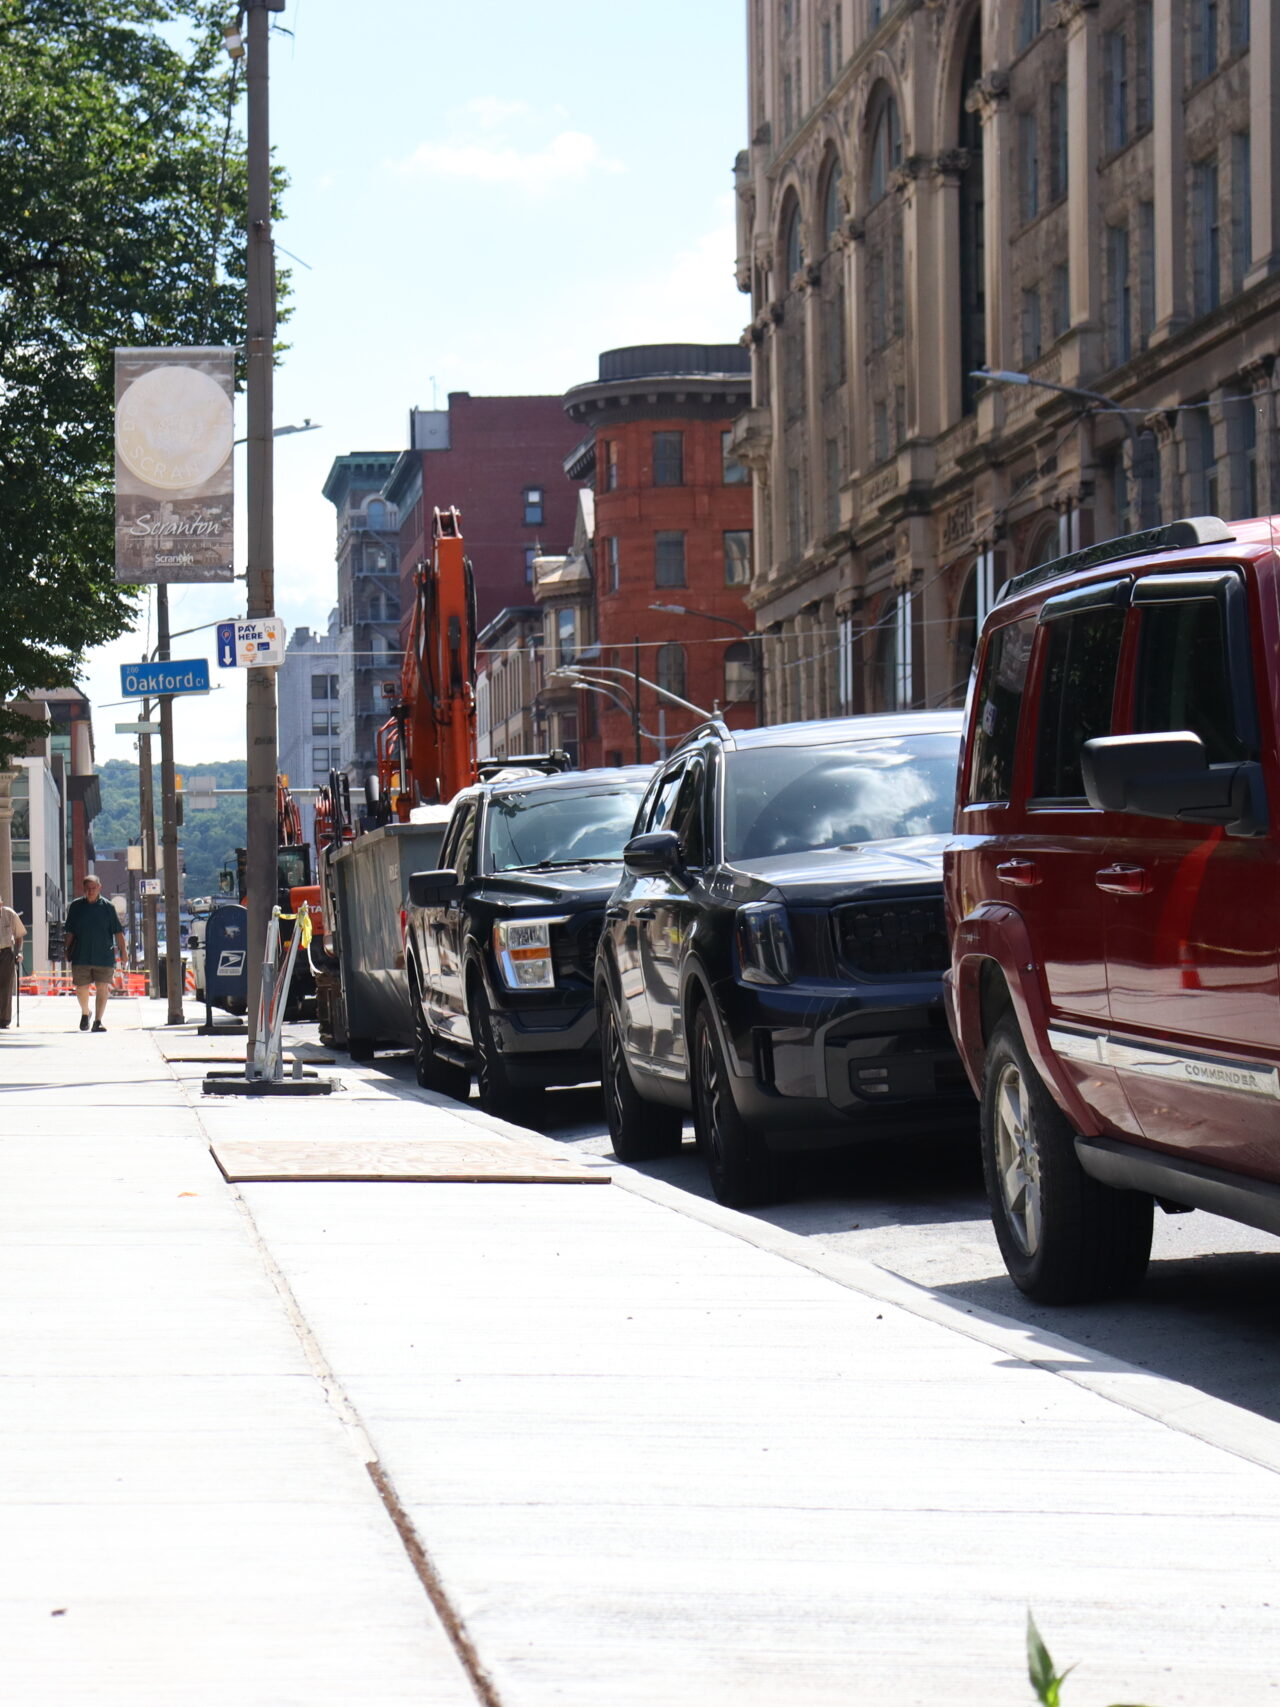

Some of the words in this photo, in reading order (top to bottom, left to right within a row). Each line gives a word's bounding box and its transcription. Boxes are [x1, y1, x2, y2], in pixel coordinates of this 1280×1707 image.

[129, 513, 220, 536] Scranton
[237, 624, 257, 633] PAY
[238, 631, 264, 641] HERE
[125, 671, 194, 692] Oakford
[1184, 1063, 1258, 1088] COMMANDER
